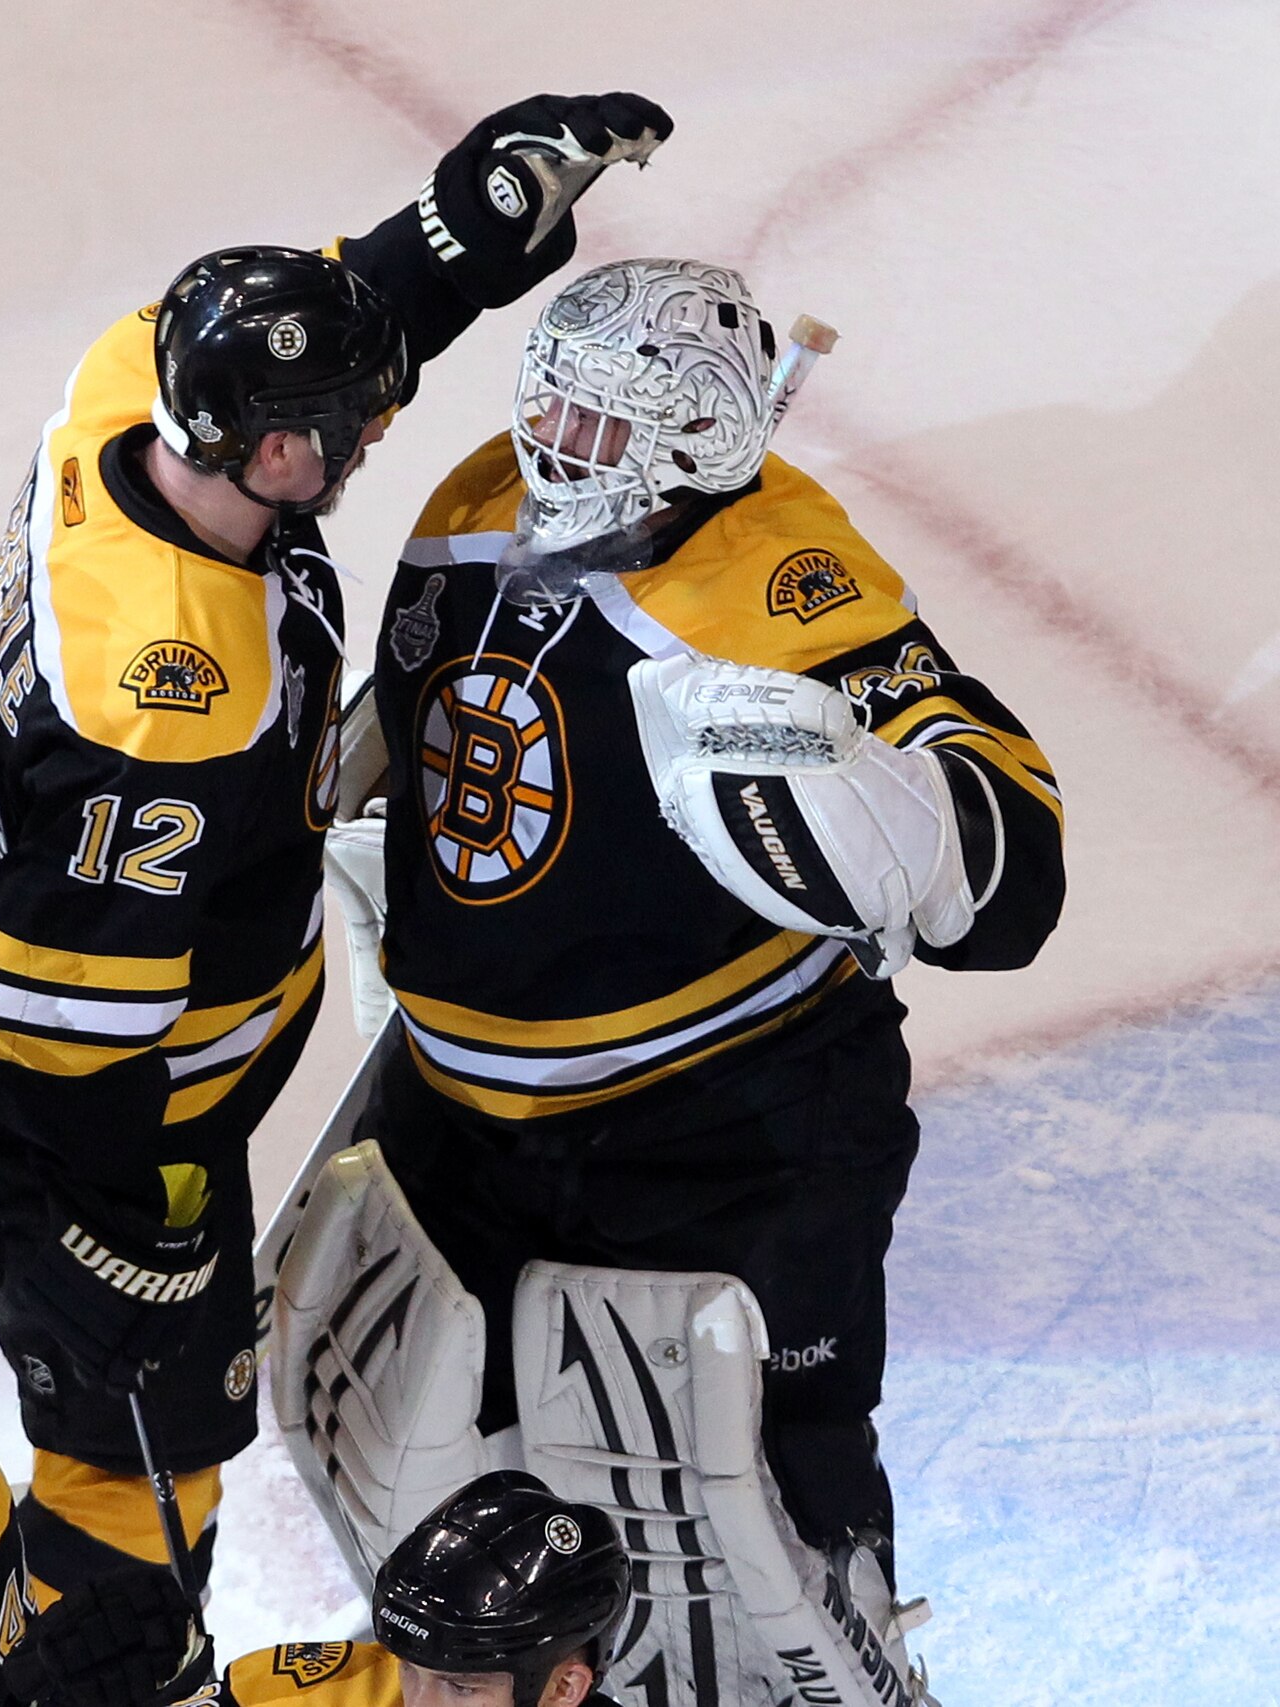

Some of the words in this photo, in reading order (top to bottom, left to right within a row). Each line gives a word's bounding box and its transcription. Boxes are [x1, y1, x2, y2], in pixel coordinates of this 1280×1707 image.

[776, 555, 846, 606] BRUINS
[130, 648, 218, 687] BRUINS
[694, 683, 796, 705] EPIC
[67, 793, 206, 896] 12
[738, 780, 808, 891] VAUGHN
[379, 1606, 430, 1641] BAUER
